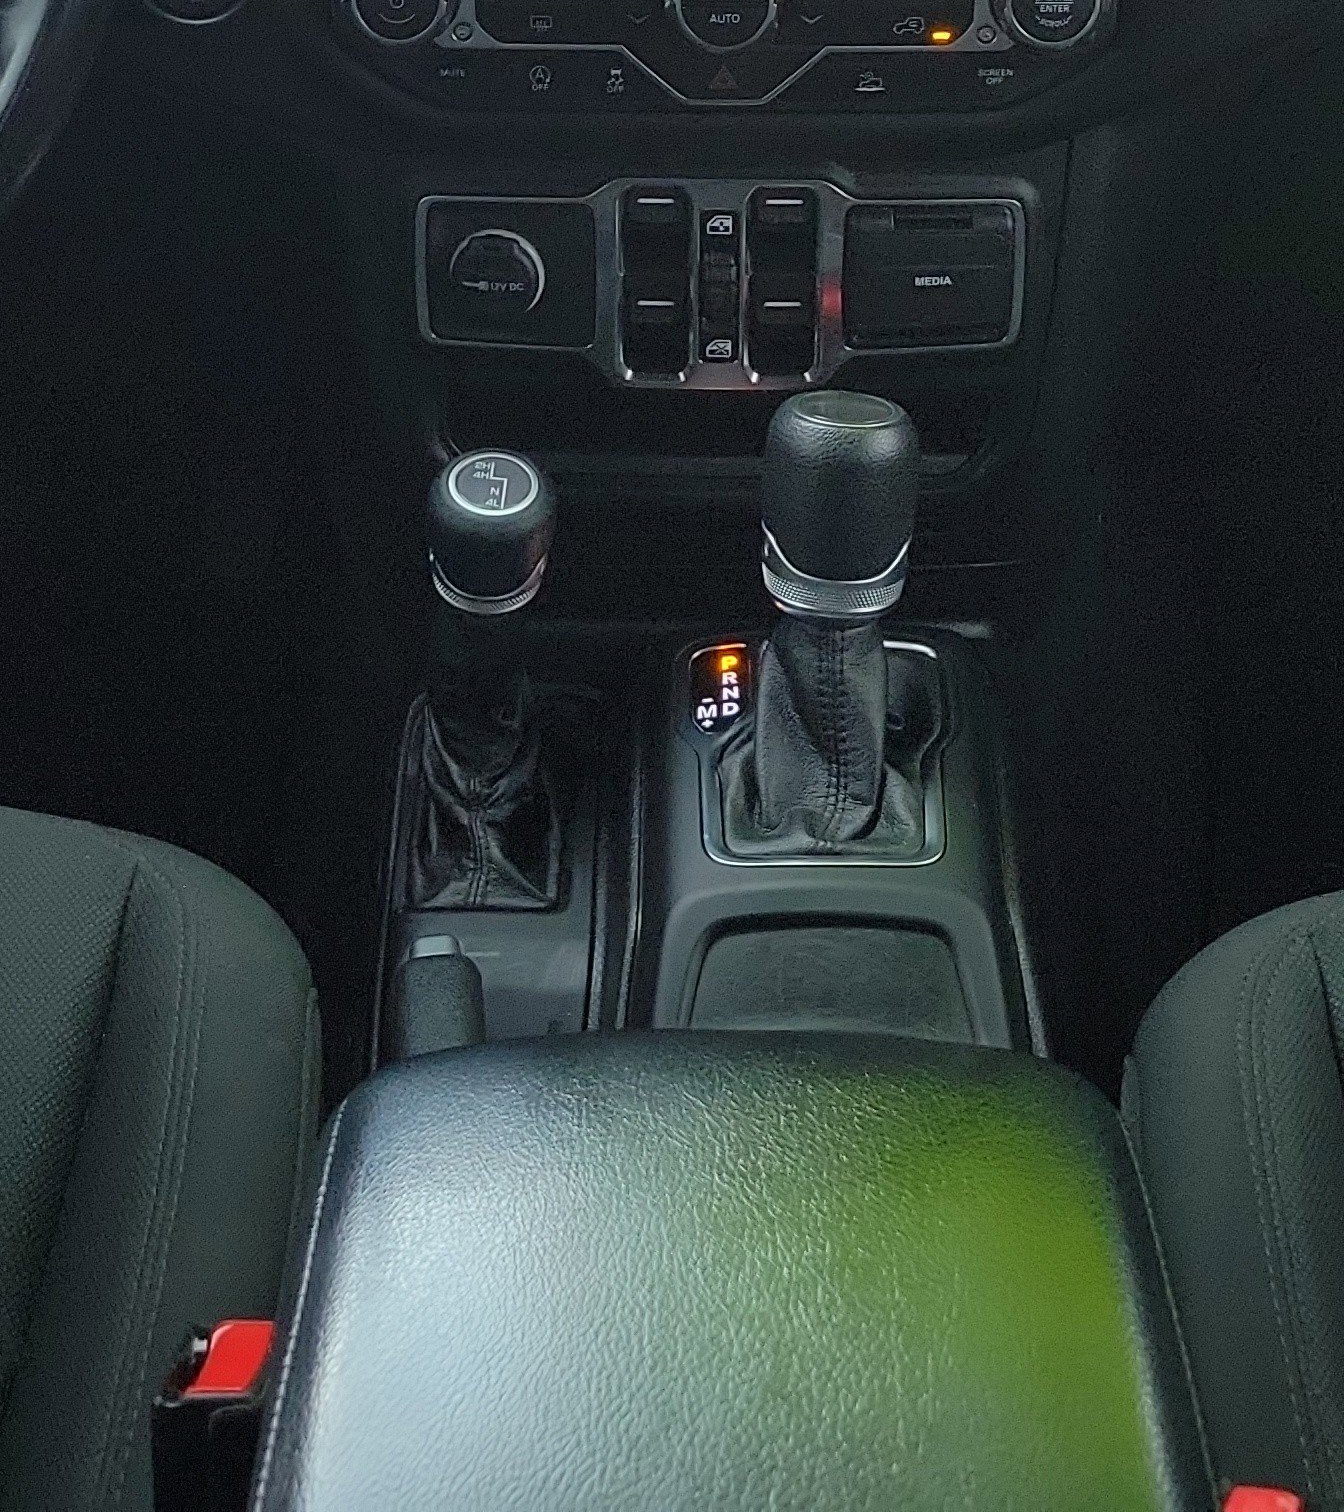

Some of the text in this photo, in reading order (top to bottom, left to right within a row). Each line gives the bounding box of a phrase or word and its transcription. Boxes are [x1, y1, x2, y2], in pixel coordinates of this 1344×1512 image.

[1039, 4, 1070, 13] ENTER
[709, 13, 741, 24] AUTO
[914, 275, 953, 287] MEDIA
[474, 461, 491, 470] 2H
[472, 471, 490, 480] 4H
[490, 487, 500, 495] N
[485, 498, 499, 507] 4L
[722, 655, 738, 670] P
[722, 671, 739, 685] R
[722, 686, 740, 700] N
[697, 702, 740, 719] M D
